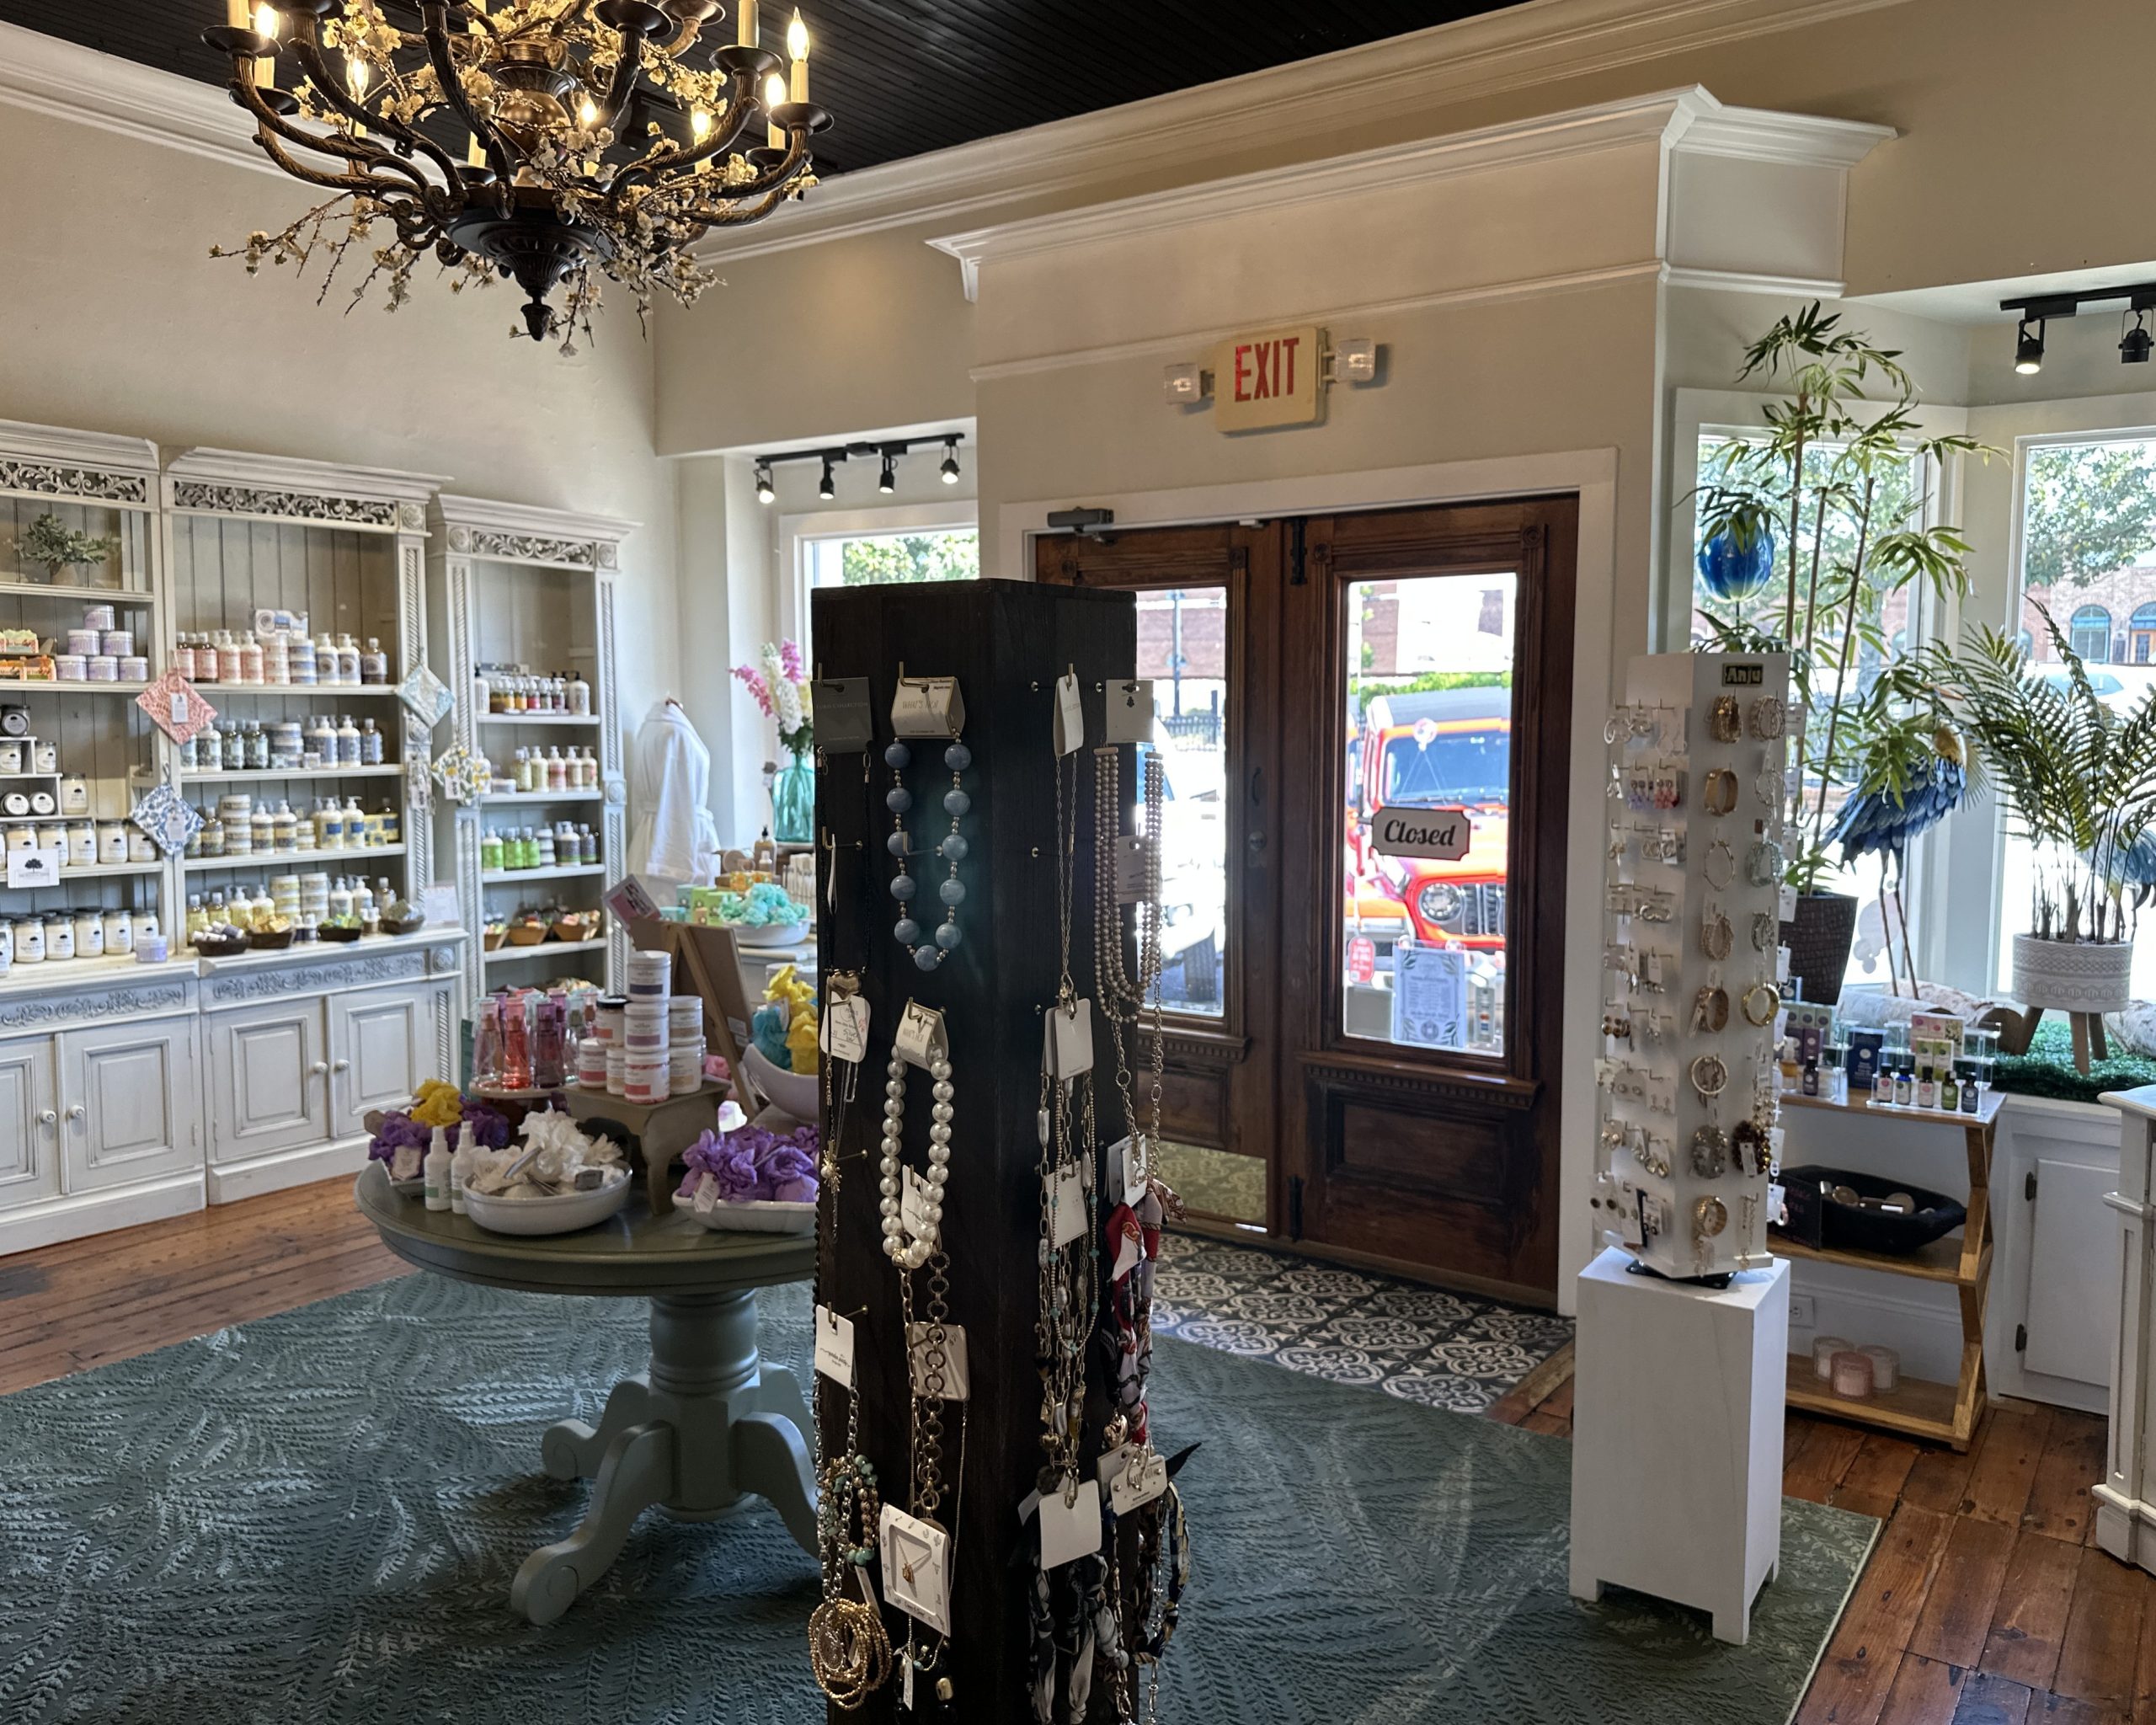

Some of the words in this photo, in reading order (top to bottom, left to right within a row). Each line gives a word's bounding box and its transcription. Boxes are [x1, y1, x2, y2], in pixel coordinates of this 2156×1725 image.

[1235, 337, 1299, 403] EXIT
[1726, 666, 1761, 684] Anju
[1384, 819, 1457, 846] Closed
